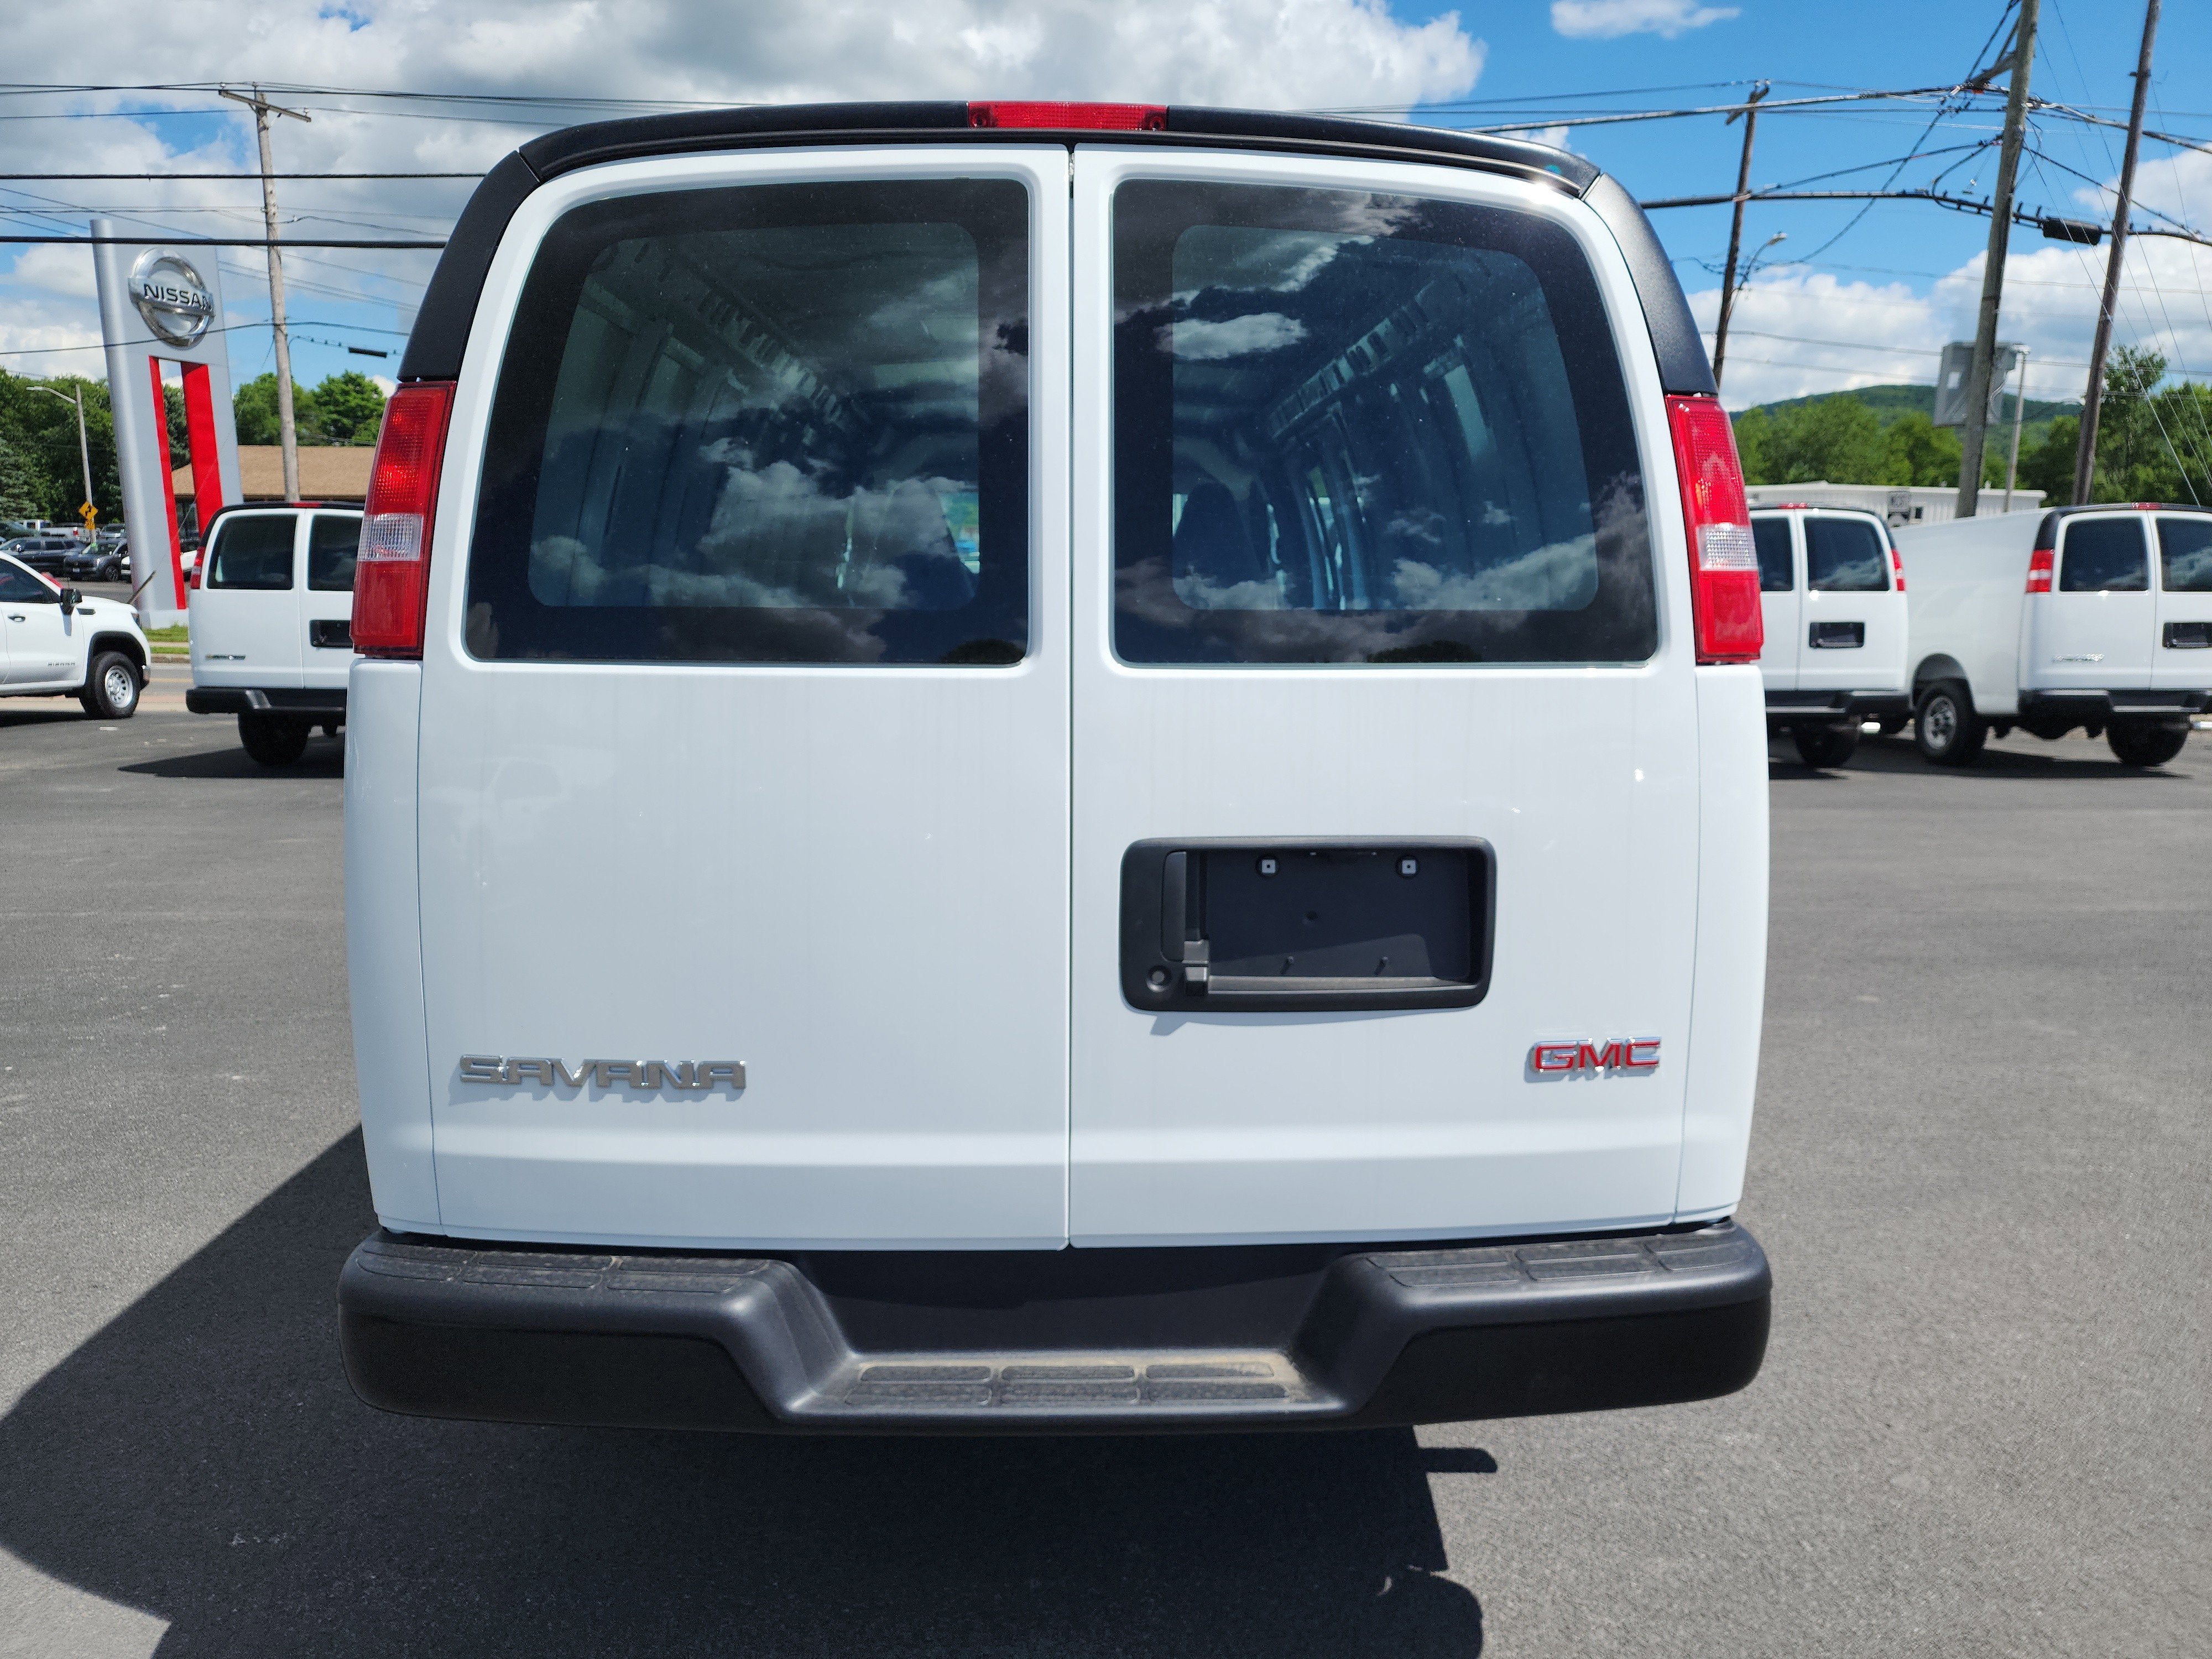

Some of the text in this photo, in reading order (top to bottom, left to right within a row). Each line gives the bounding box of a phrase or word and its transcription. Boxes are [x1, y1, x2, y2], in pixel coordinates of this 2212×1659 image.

[144, 283, 212, 311] NISSAN
[460, 1054, 745, 1089] SAVANA
[1533, 1036, 1661, 1072] GMC
